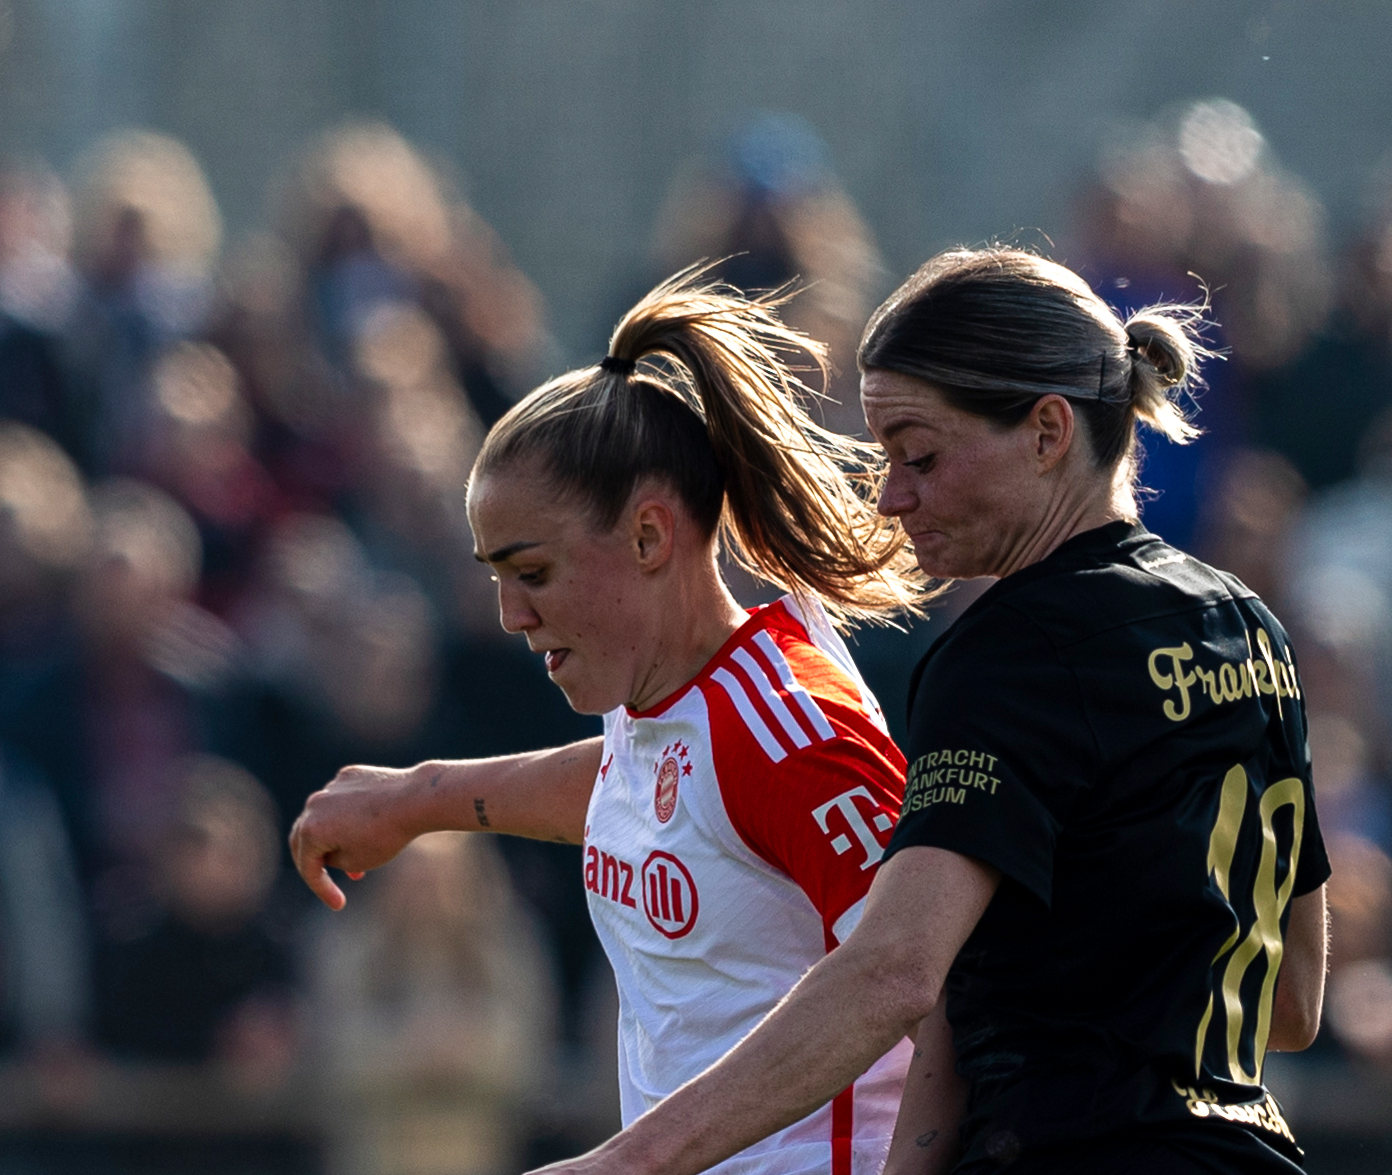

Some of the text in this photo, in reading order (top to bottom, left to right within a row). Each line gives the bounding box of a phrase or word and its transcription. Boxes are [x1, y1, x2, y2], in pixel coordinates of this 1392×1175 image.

[900, 787, 966, 817] USEUM
[585, 844, 636, 909] anz
[1195, 763, 1305, 1086] 18
